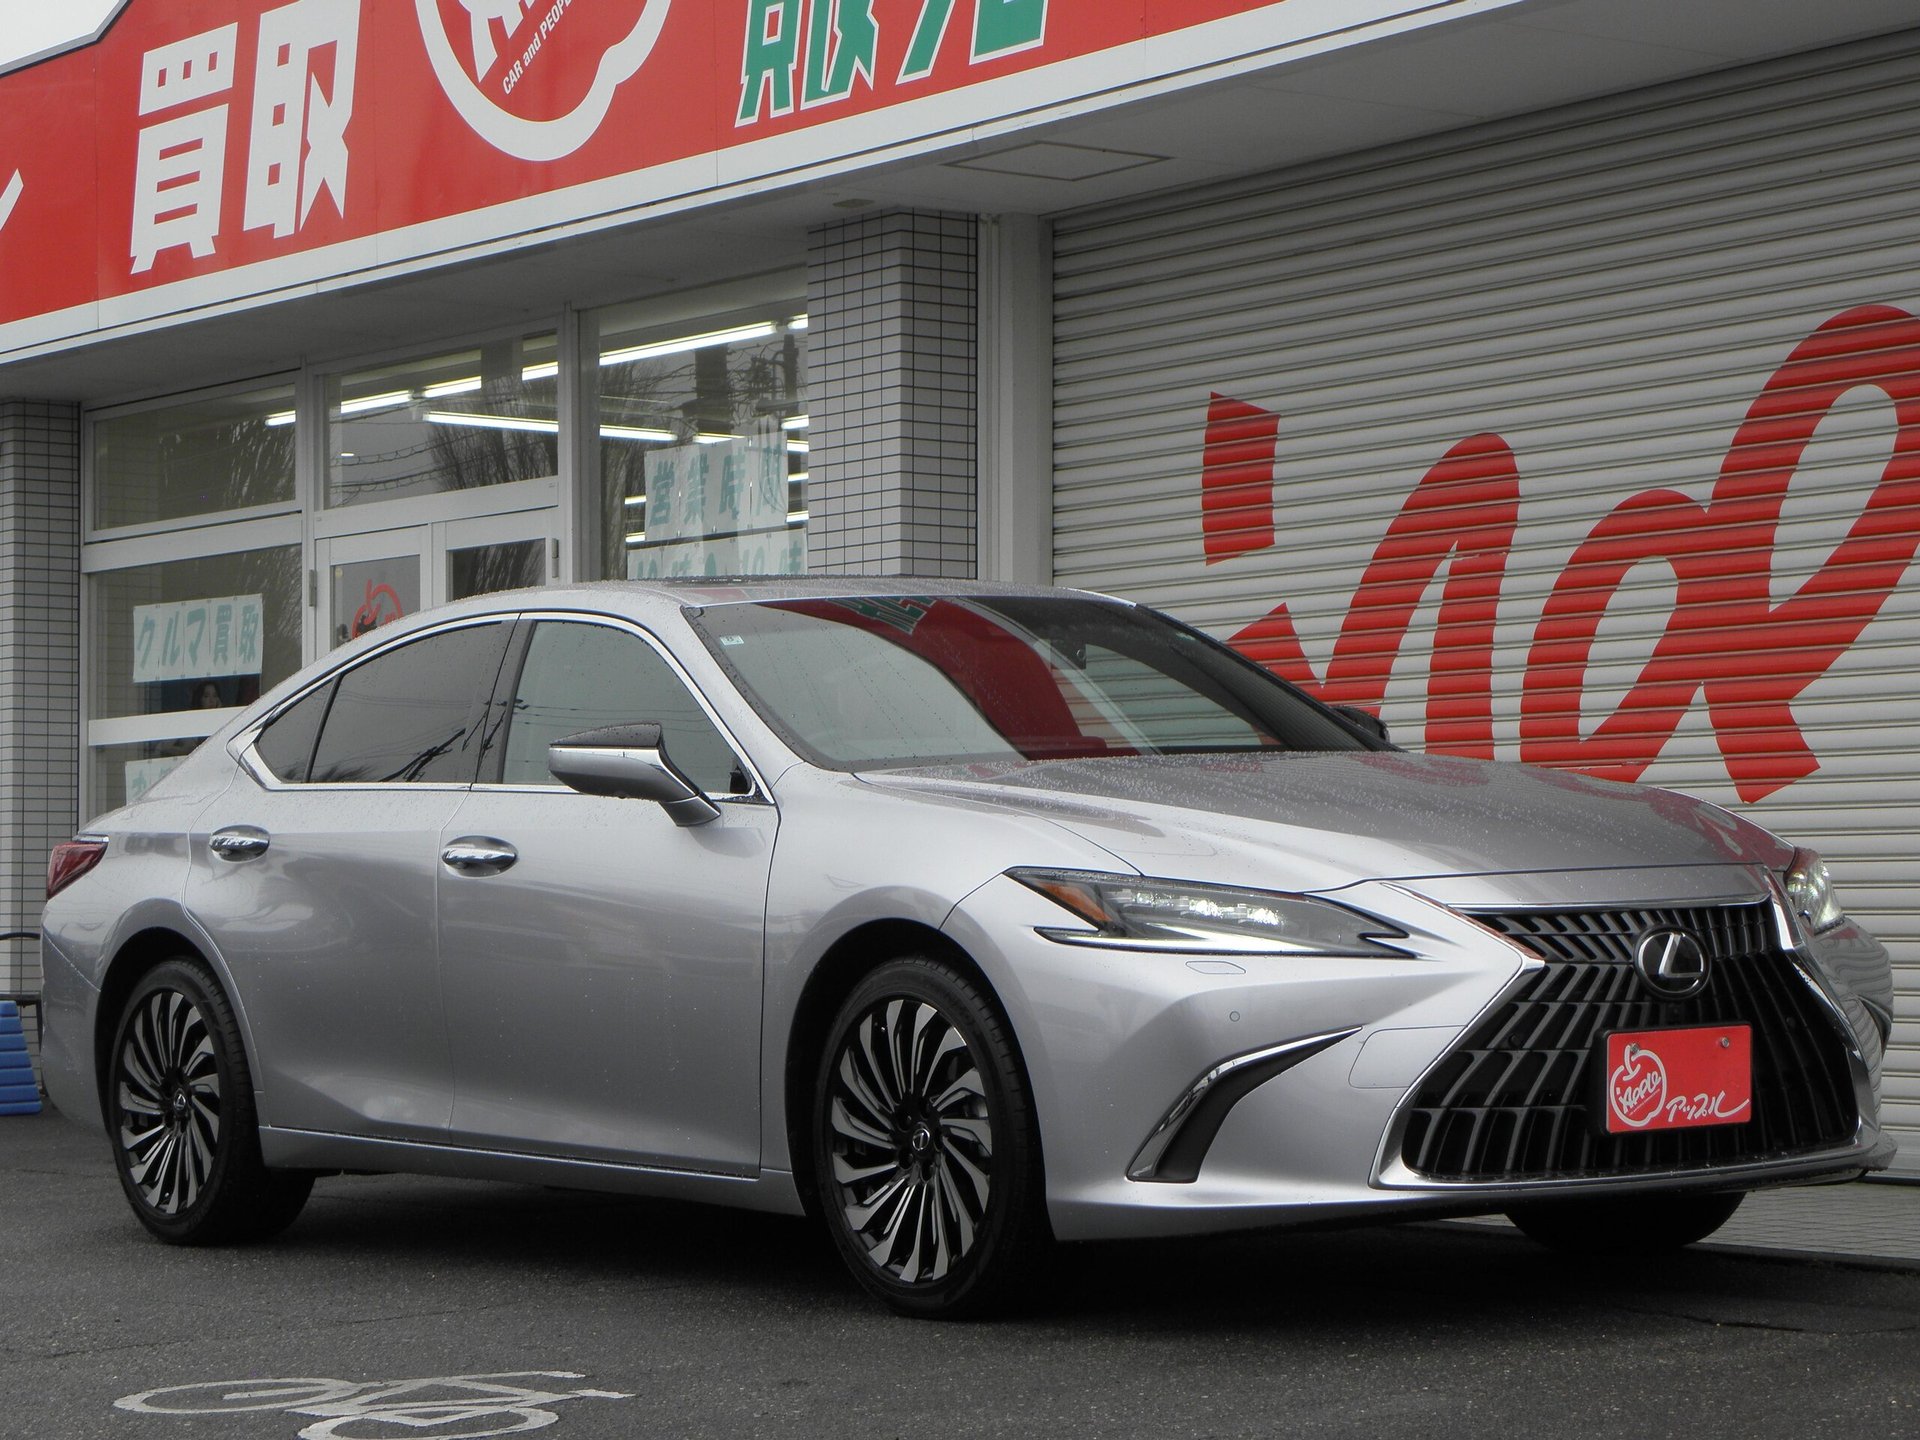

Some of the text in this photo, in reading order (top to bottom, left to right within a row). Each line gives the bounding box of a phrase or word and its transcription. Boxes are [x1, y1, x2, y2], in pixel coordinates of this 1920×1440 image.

[502, 59, 523, 95] CAR
[522, 32, 542, 67] and
[130, 0, 361, 275] 買取
[136, 603, 260, 671] クルマ買取
